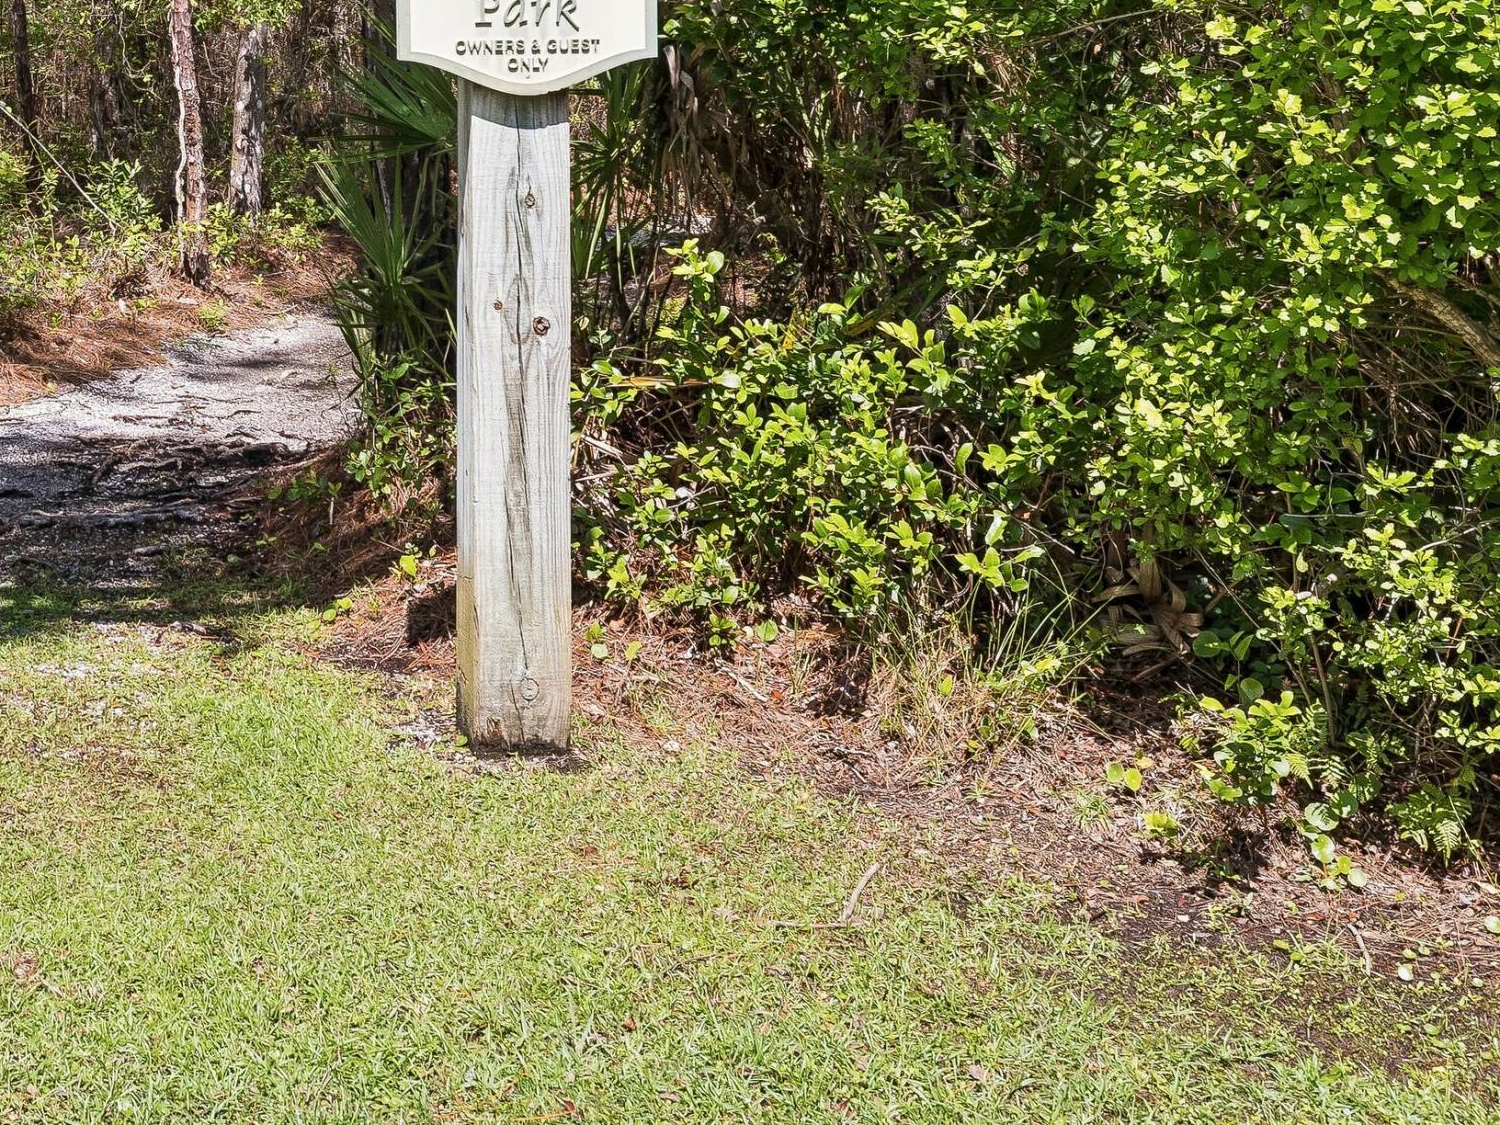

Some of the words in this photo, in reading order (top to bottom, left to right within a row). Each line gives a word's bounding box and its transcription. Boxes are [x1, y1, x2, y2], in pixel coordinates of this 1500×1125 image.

[455, 39, 525, 56] OWNERS
[531, 40, 542, 54] &
[547, 38, 601, 55] GUEST
[507, 57, 549, 73] ONLY
